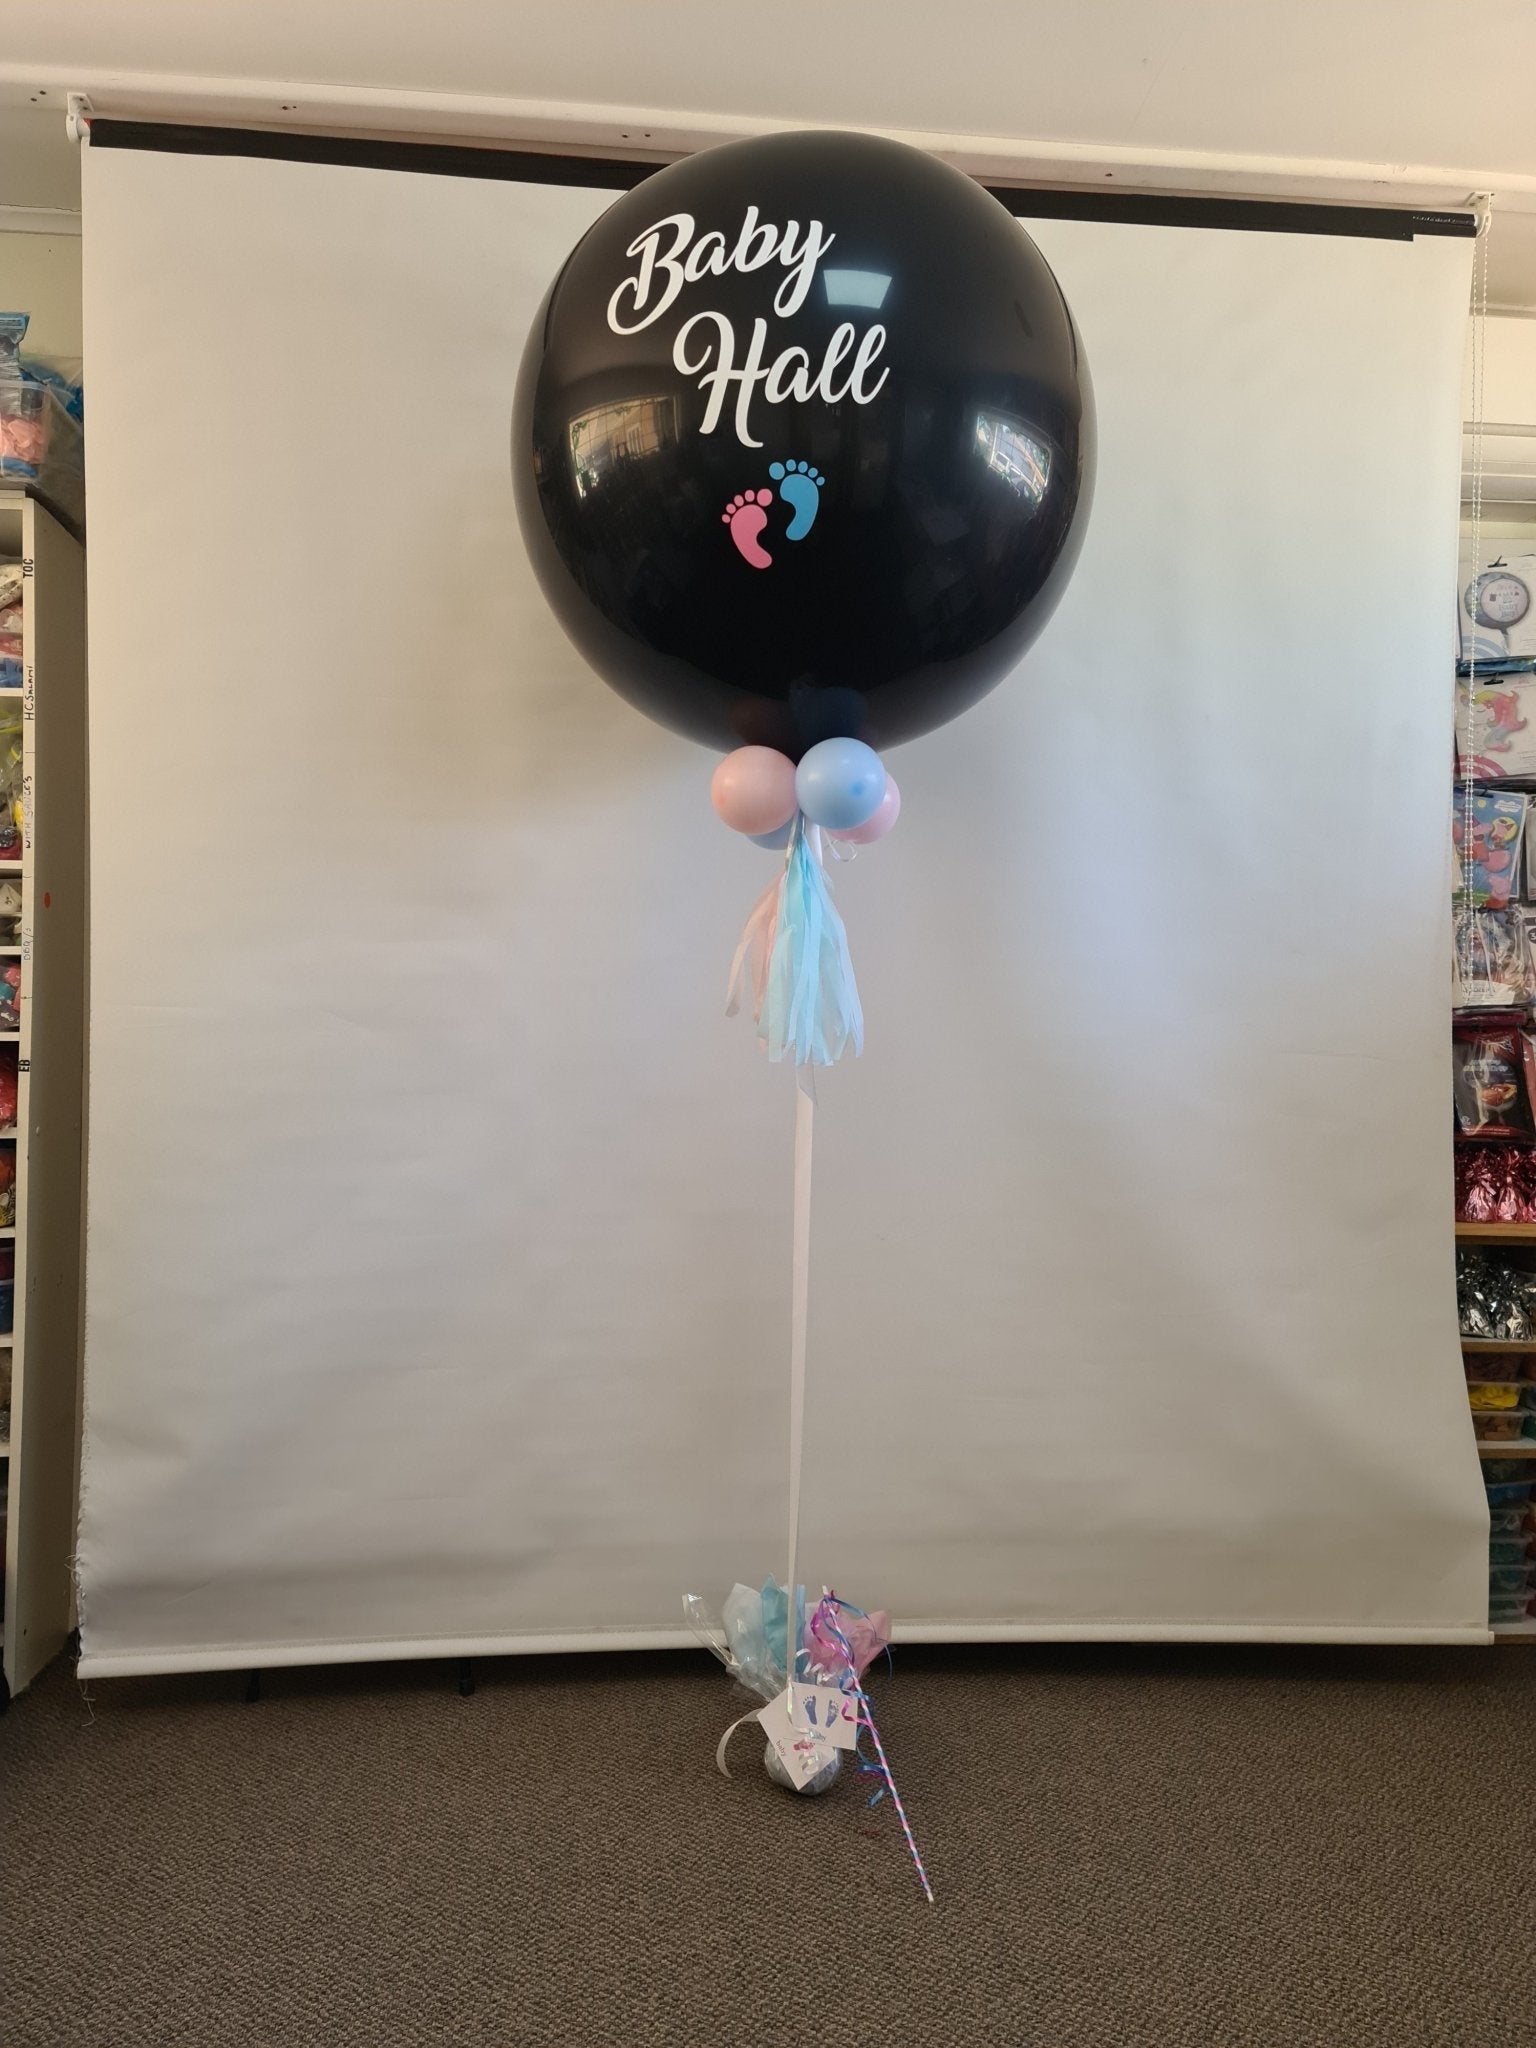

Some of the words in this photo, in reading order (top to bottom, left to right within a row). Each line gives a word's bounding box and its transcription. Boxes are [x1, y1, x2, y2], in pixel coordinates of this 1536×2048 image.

[607, 206, 836, 335] Baby
[672, 311, 890, 448] Hall
[23, 558, 34, 579] TOC
[18, 1059, 30, 1073] EB
